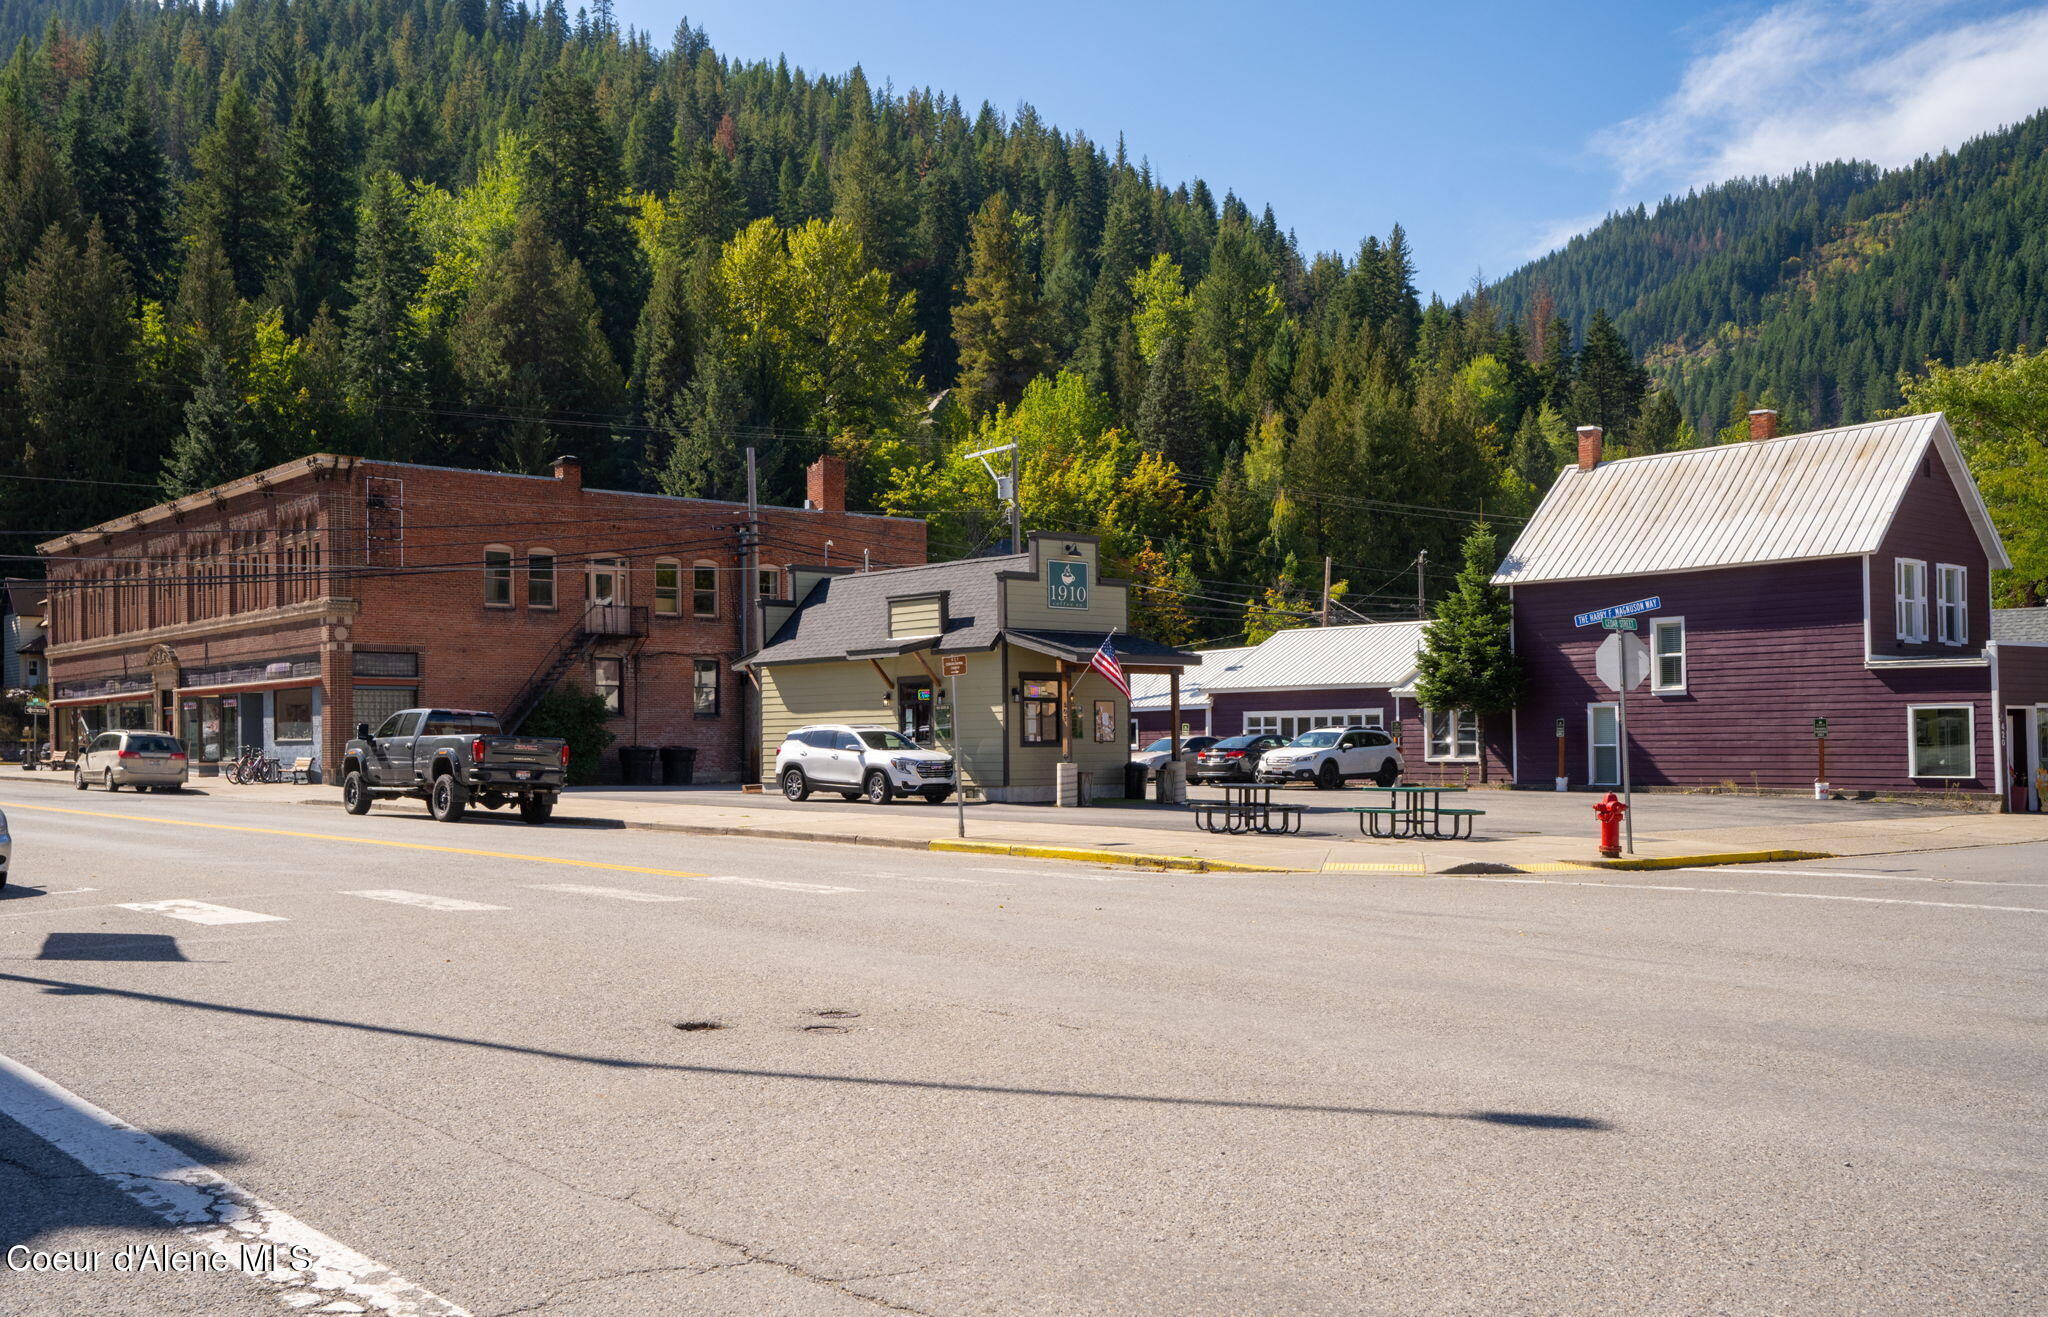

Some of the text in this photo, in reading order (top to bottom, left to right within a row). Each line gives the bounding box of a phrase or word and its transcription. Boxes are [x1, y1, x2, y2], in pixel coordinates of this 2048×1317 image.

[1050, 585, 1086, 602] 1910
[1578, 615, 1589, 625] THE
[1589, 610, 1607, 622] HARRY
[1615, 602, 1644, 616] MAGNUSON
[1644, 599, 1657, 609] WAY
